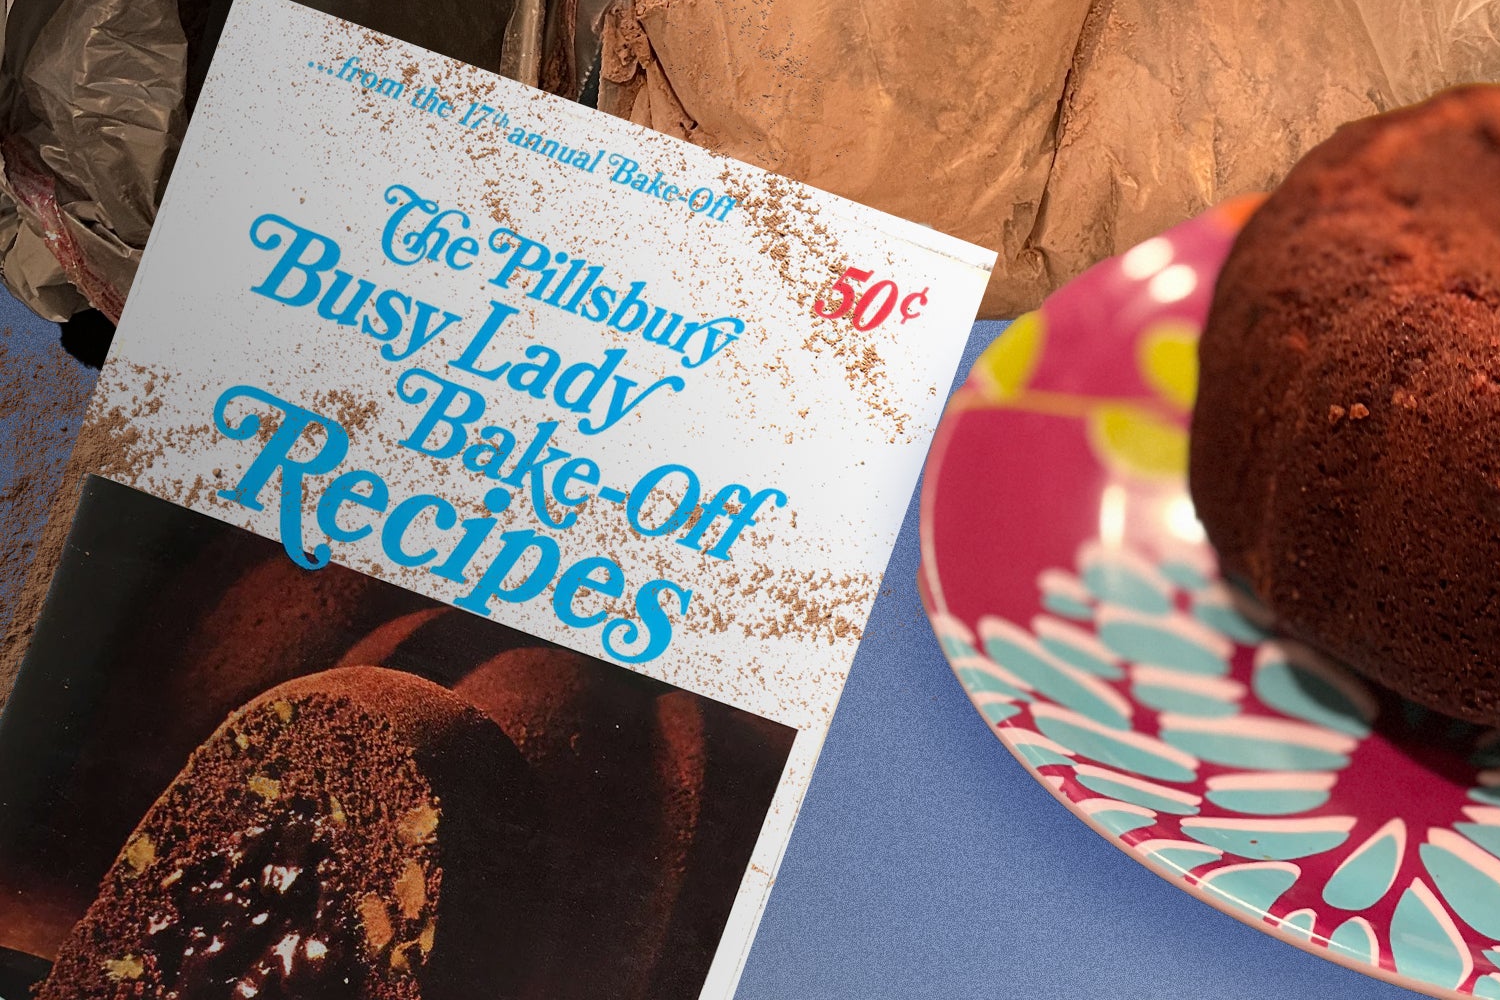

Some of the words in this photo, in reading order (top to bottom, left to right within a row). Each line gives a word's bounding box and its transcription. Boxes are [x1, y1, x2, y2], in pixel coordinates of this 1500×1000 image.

[411, 85, 456, 119] the
[457, 101, 511, 131] 17th
[506, 126, 606, 174] annual
[608, 152, 742, 223] Bake-Off
[248, 213, 463, 362] Busy
[458, 299, 686, 437] Lady
[381, 184, 482, 272] The
[488, 227, 747, 370] Pillsbury
[813, 265, 929, 334] 50¢
[212, 383, 697, 666] Recipes
[395, 367, 790, 564] Bake-Off
